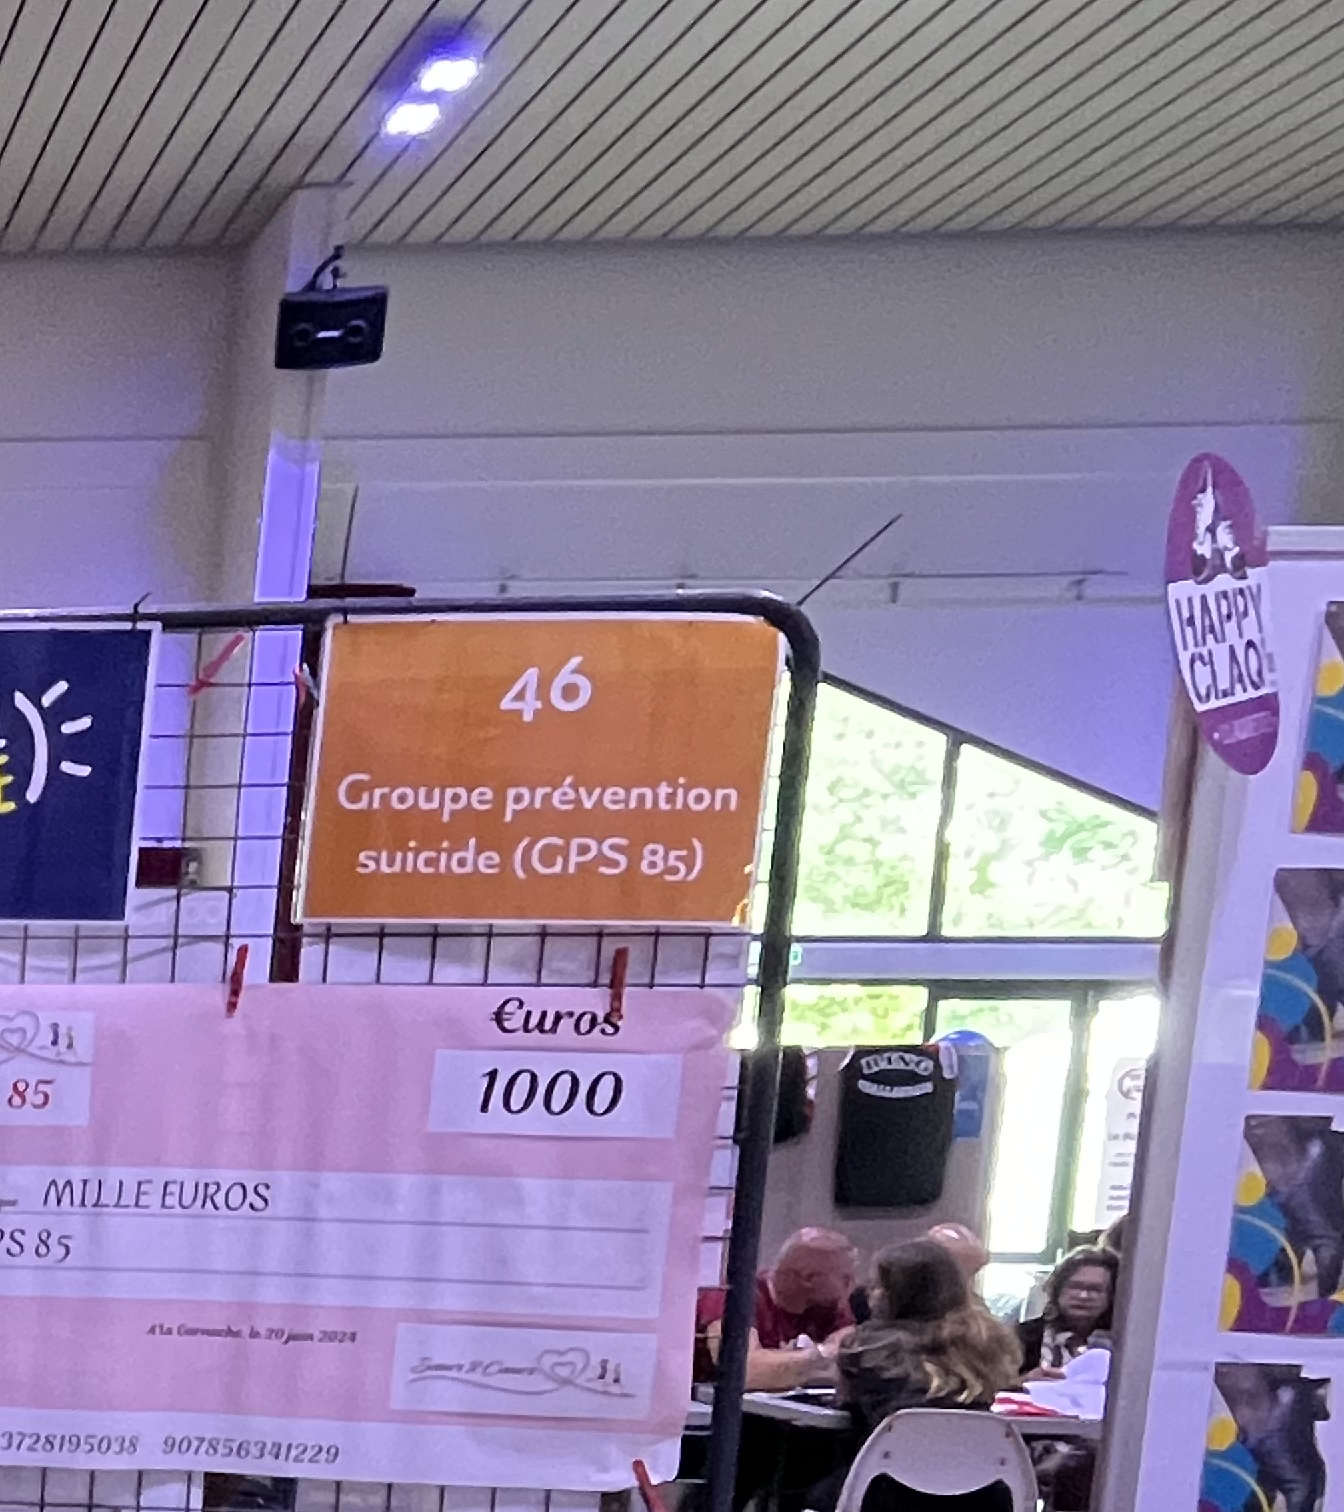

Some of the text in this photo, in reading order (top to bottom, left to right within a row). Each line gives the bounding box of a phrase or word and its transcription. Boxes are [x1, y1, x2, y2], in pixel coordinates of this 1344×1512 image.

[1175, 583, 1264, 651] HAPPY
[499, 654, 593, 723] 46
[336, 772, 740, 823] Groupe prévention
[355, 836, 704, 881] suicide (GPS 85)
[7, 1078, 55, 1110] 85
[479, 1067, 624, 1117] 1000
[42, 1178, 153, 1209] MILLE
[160, 1180, 272, 1212] EUROS
[35, 1229, 74, 1264] 85
